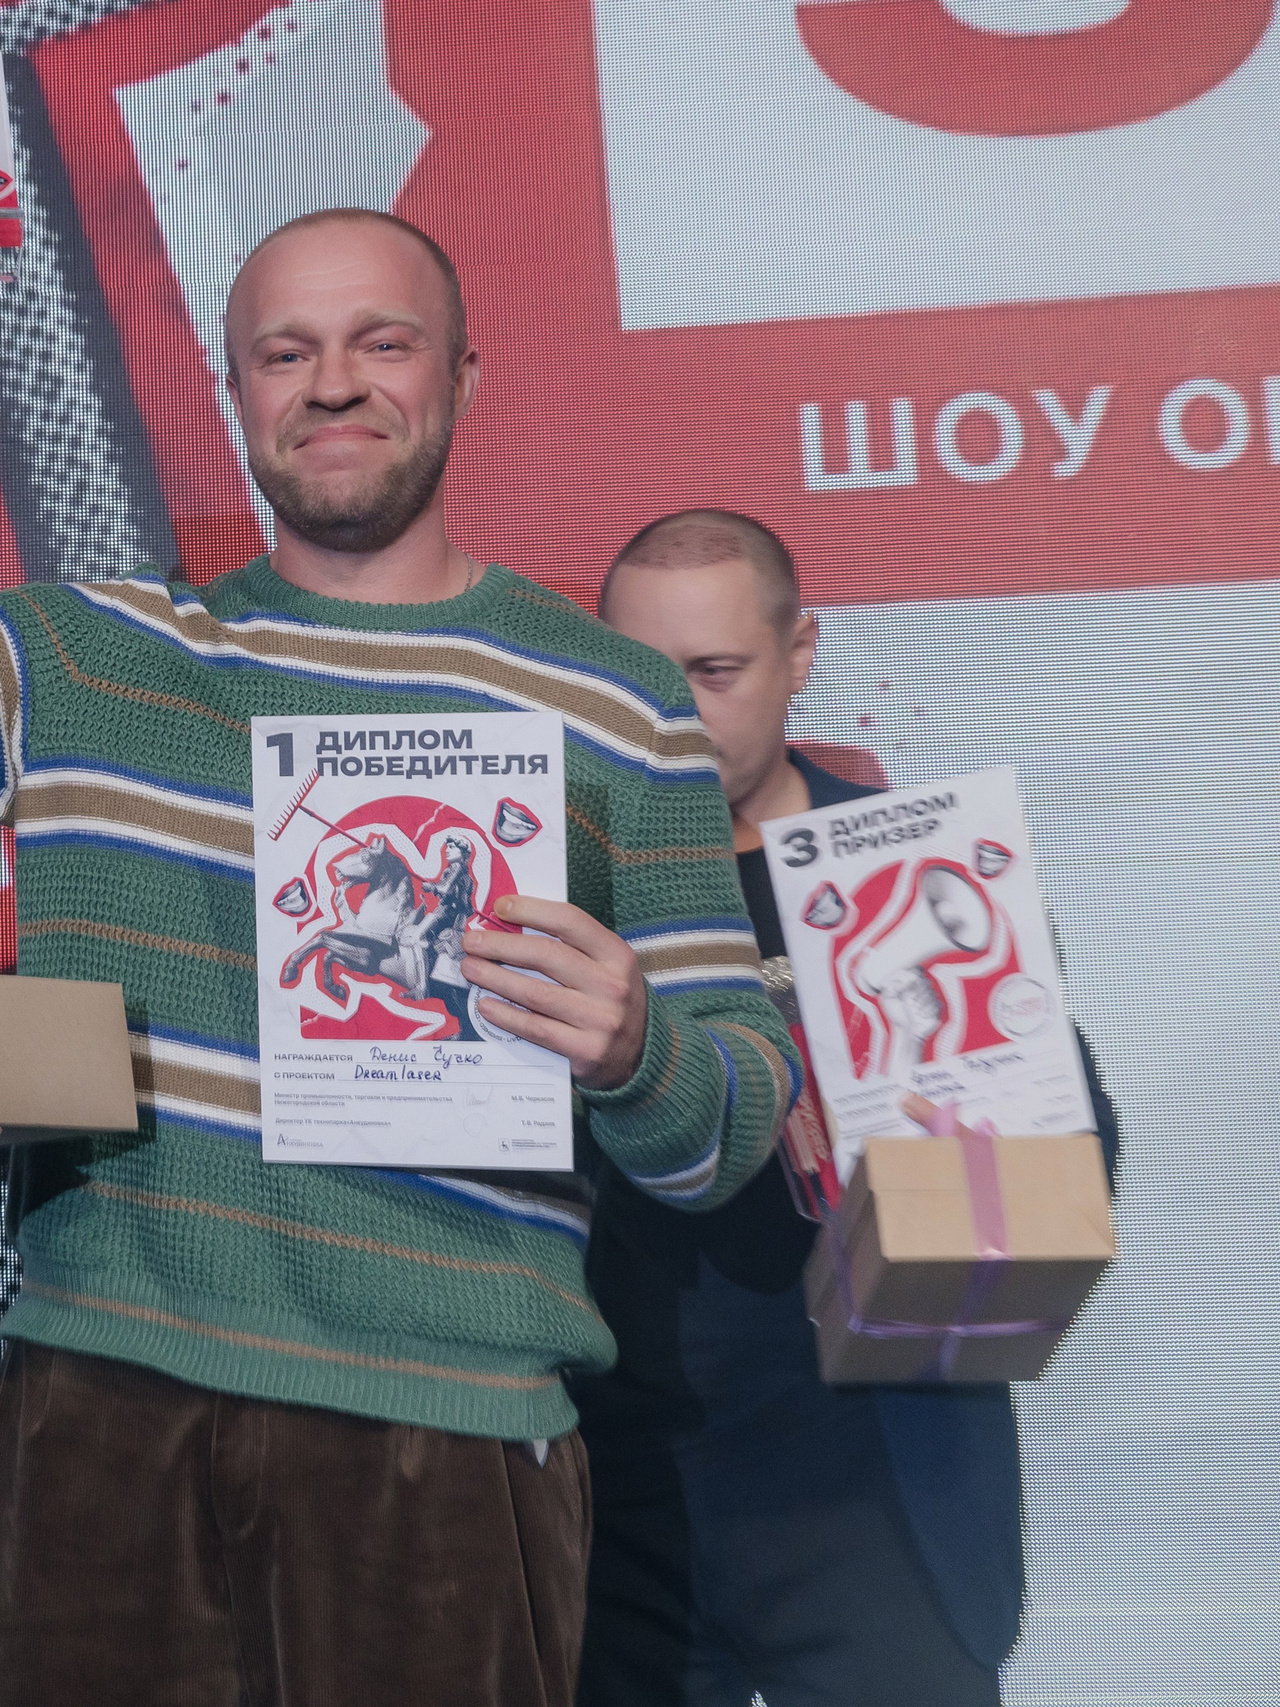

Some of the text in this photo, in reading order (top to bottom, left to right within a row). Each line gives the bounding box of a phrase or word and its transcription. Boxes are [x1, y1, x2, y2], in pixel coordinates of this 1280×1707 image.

[799, 376, 1280, 492] ШОУ О
[316, 729, 473, 754] ДИПЛОМ
[266, 732, 294, 777] 1
[316, 754, 548, 779] ПОБЕДИТЕЛЯ
[829, 791, 958, 839] ДИПЛОМ
[780, 827, 818, 868] 3
[274, 1053, 353, 1062] НАГРАЖДАЕТСЯ
[370, 1046, 417, 1063] Денис
[282, 1072, 335, 1080] ПРОЕКТОМ
